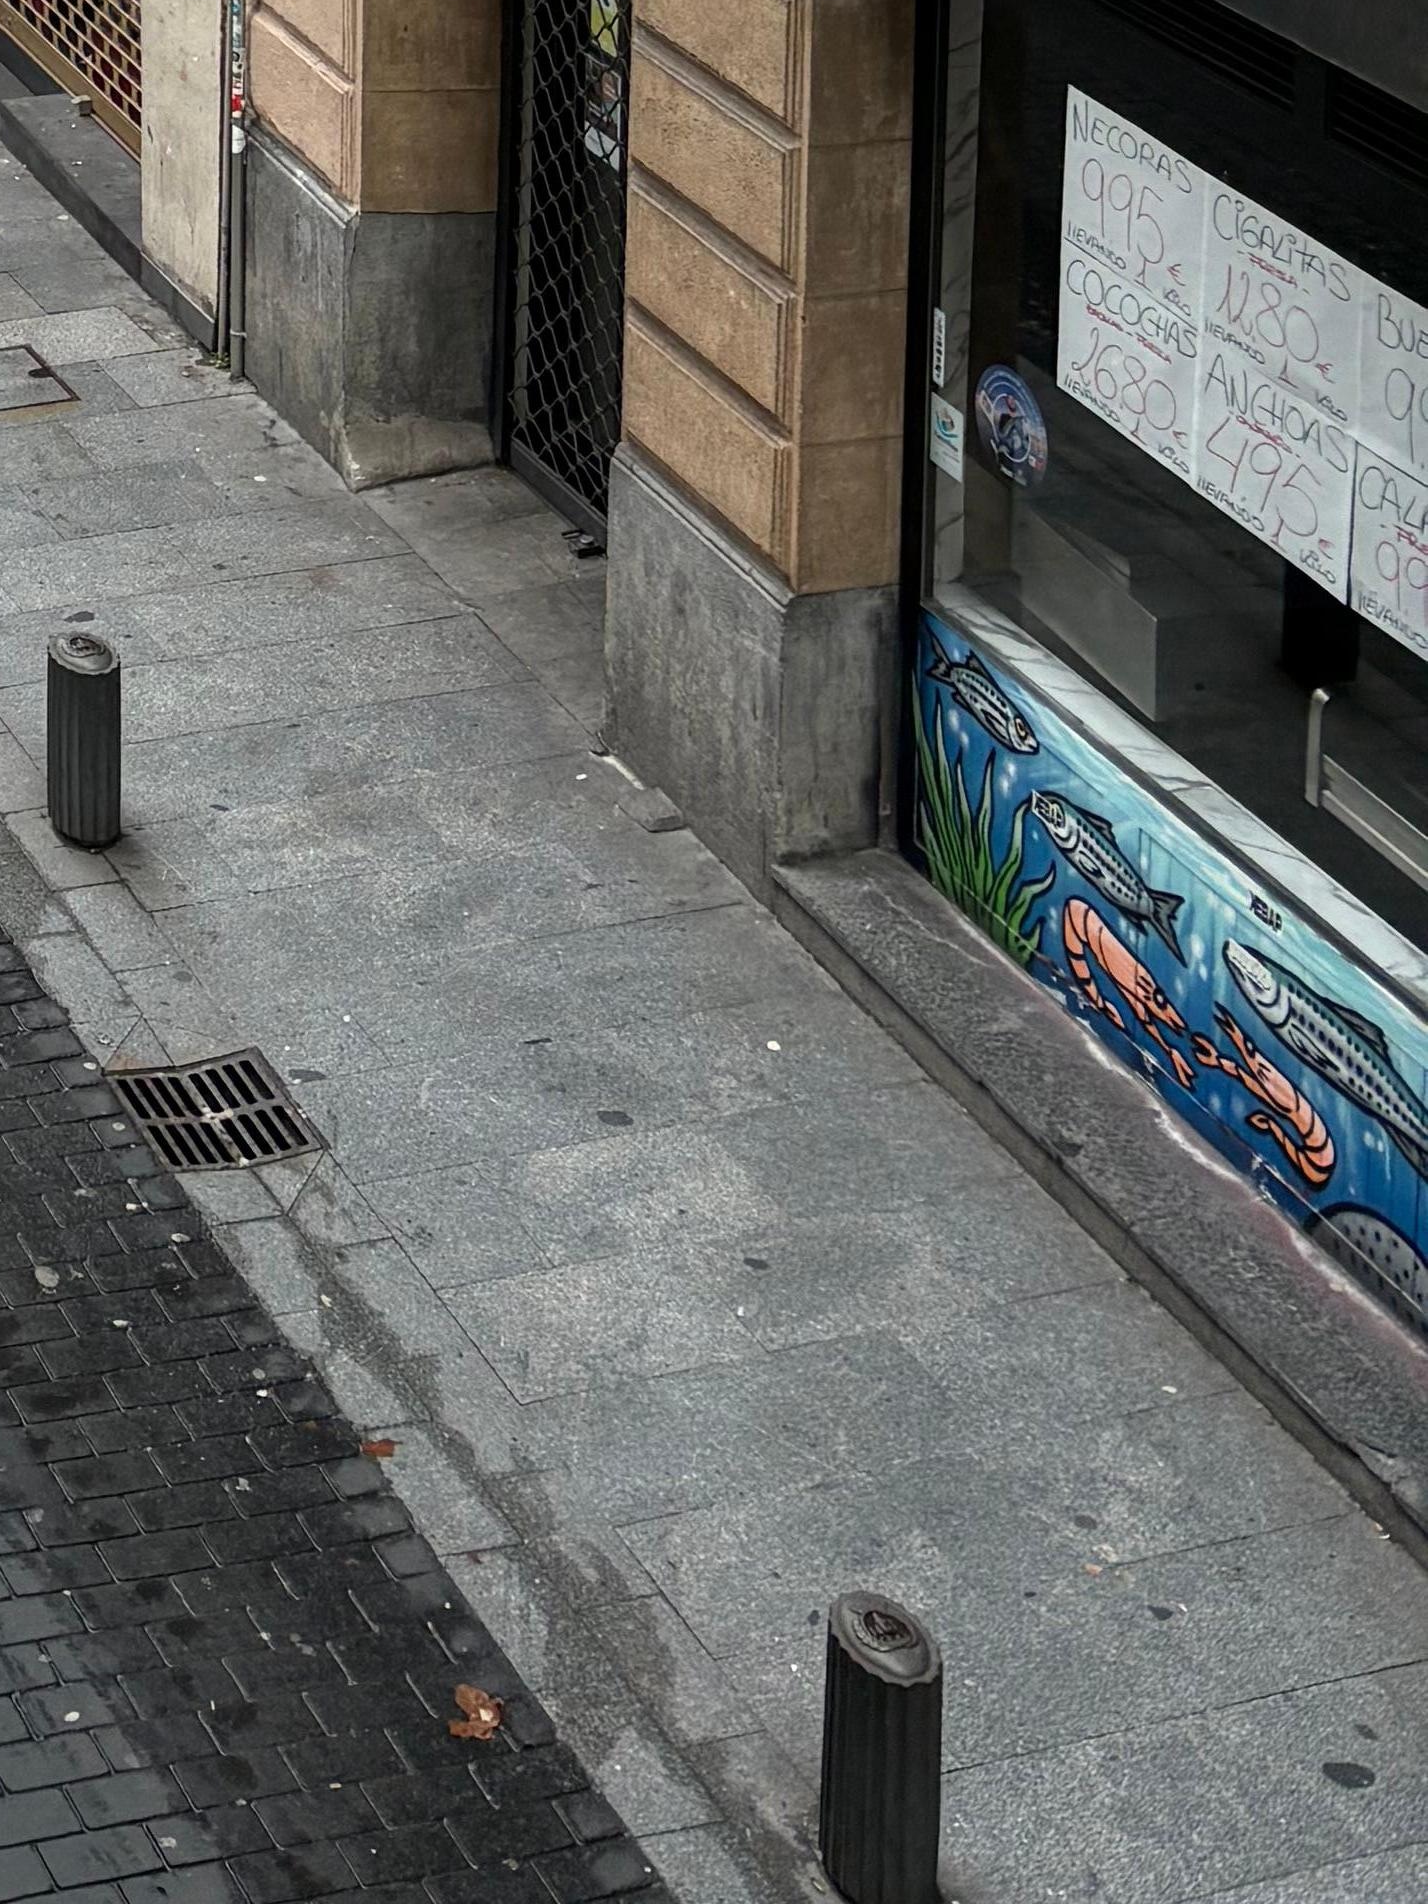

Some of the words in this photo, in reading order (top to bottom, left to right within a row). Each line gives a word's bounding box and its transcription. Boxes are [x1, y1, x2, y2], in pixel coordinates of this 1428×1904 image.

[1072, 100, 1193, 194] NECORAS
[1065, 259, 1198, 359] COCOCHAS
[1204, 353, 1349, 474] ANCHOAS
